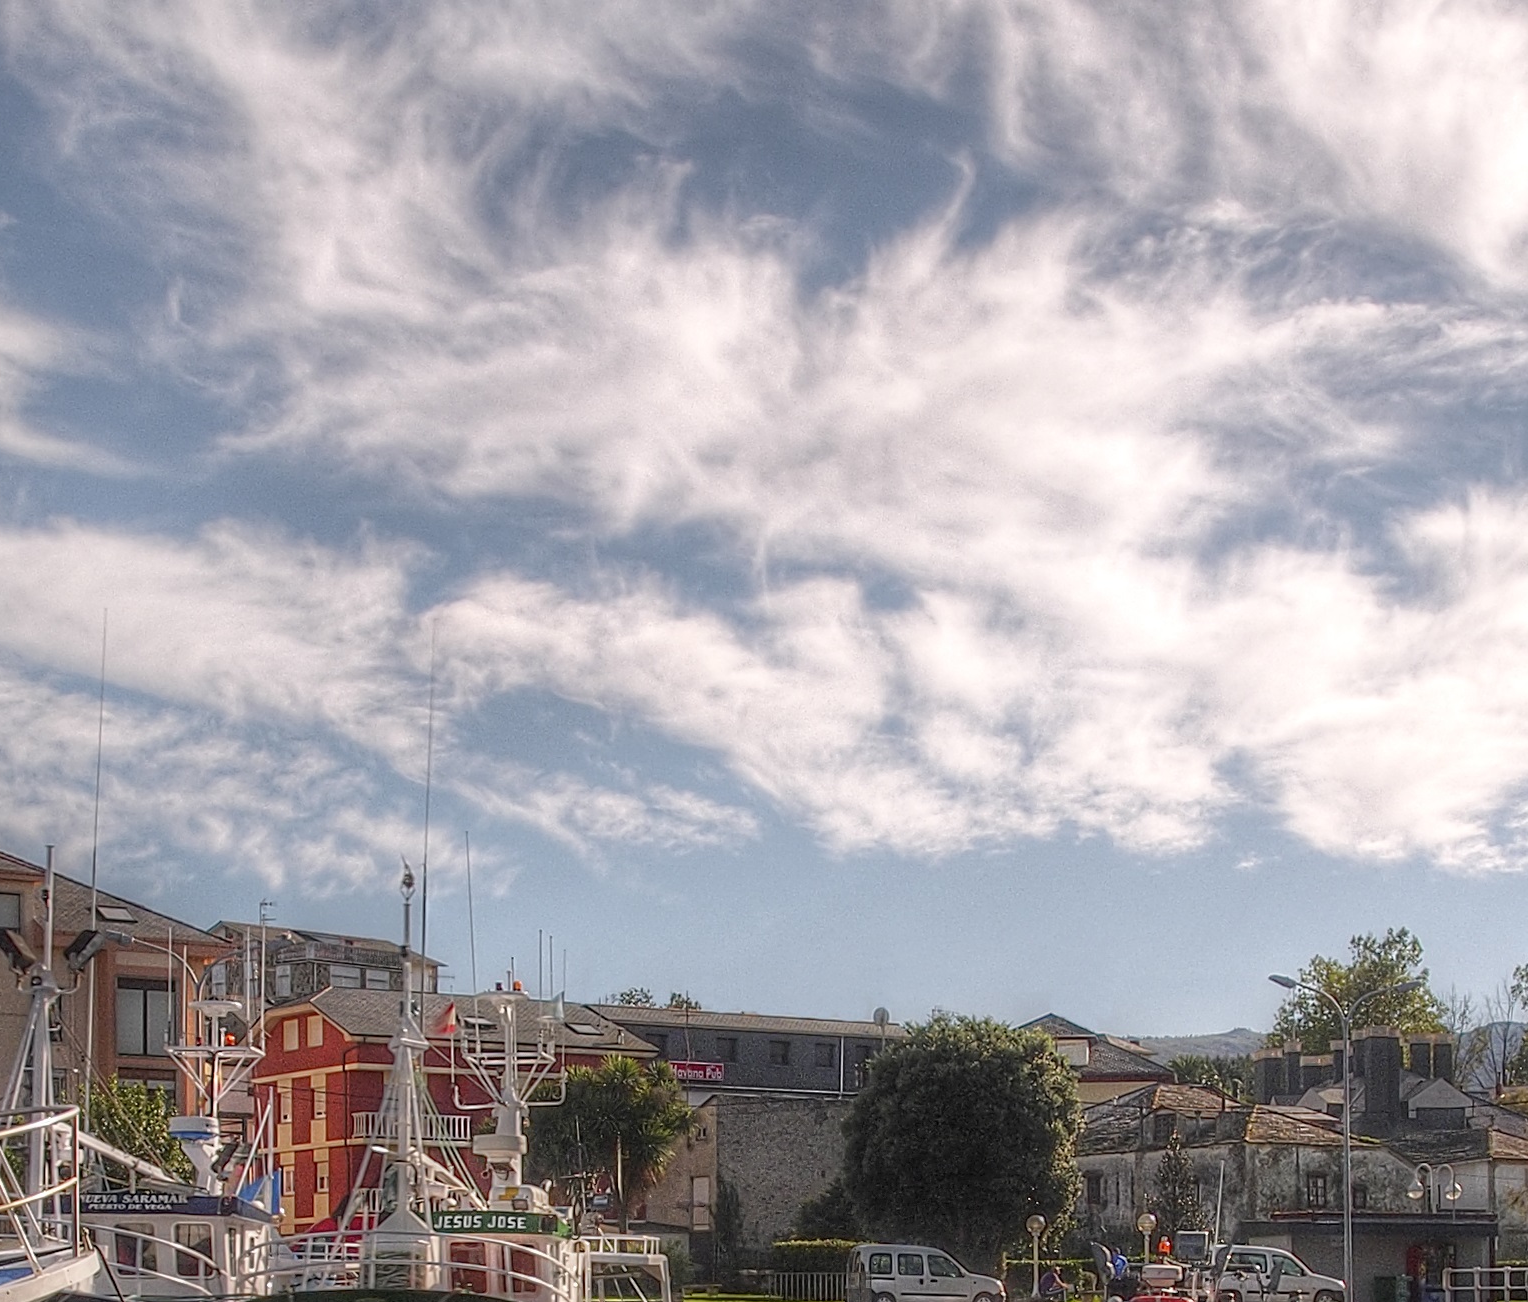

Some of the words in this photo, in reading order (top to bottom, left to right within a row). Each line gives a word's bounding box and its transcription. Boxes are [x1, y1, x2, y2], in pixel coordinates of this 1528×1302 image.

[706, 1066, 722, 1079] Pub
[434, 1216, 482, 1229] JESUS
[487, 1216, 526, 1229] JOSE
